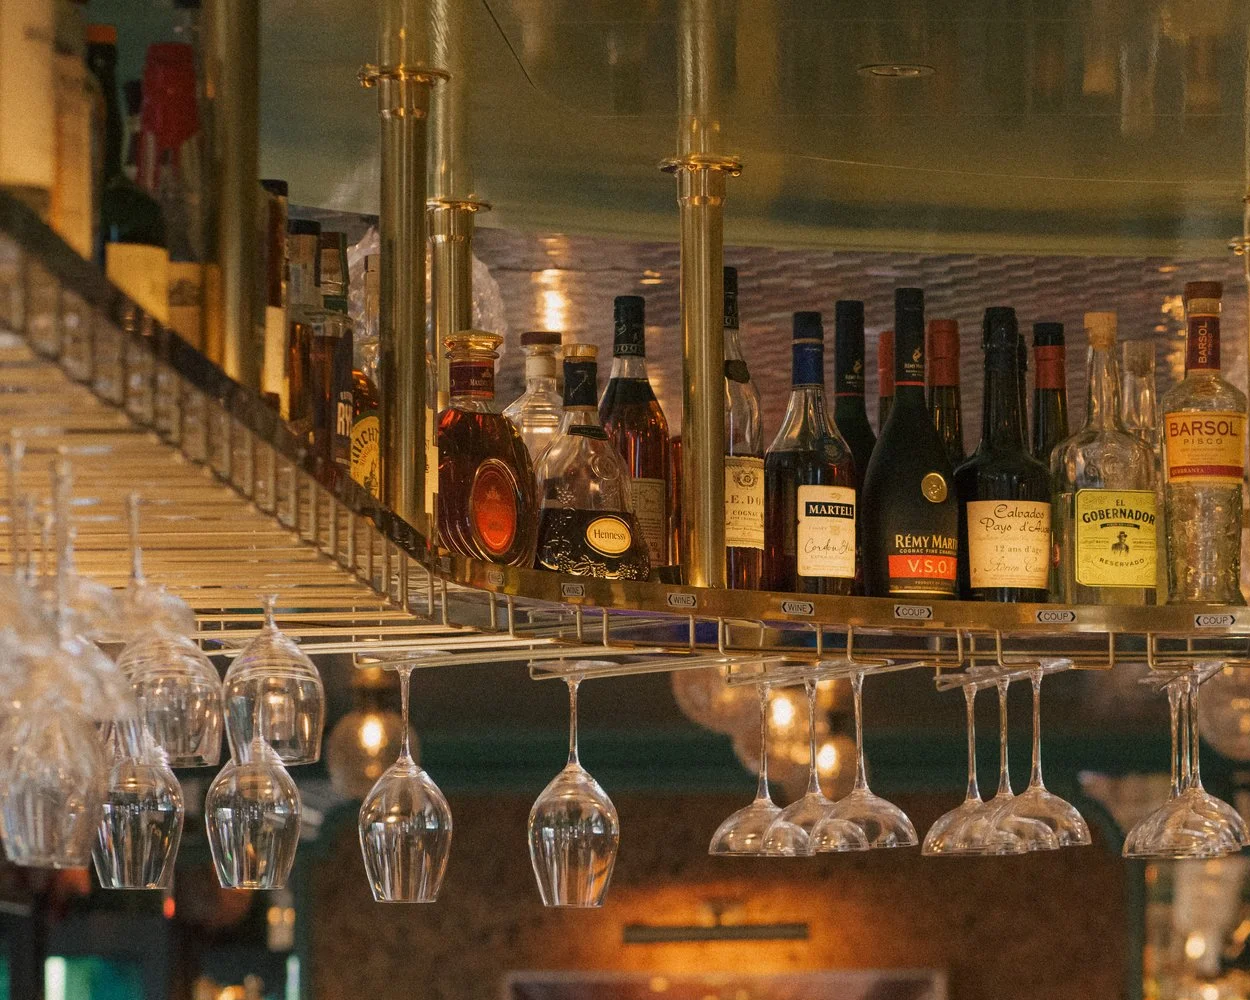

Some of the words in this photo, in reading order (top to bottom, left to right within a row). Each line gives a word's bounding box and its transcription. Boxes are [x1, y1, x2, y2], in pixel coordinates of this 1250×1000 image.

[1198, 321, 1208, 364] BARSOL
[1169, 420, 1238, 437] BARSOL
[1184, 437, 1223, 445] PISCO
[1116, 499, 1126, 507] EL
[809, 504, 853, 517] MARTELL
[993, 503, 1045, 519] Calvados
[1082, 508, 1155, 525] GOBERNADOR
[980, 517, 1012, 534] Pays
[593, 529, 626, 543] Hennessy
[895, 533, 930, 548] RÉMY
[804, 538, 838, 555] Cordon
[1099, 557, 1145, 567] RESERVADO
[673, 596, 692, 605] WINE
[787, 602, 808, 613] WINE
[901, 608, 926, 617] COUP
[1042, 611, 1069, 621] COUP
[1202, 616, 1228, 625] COUP
